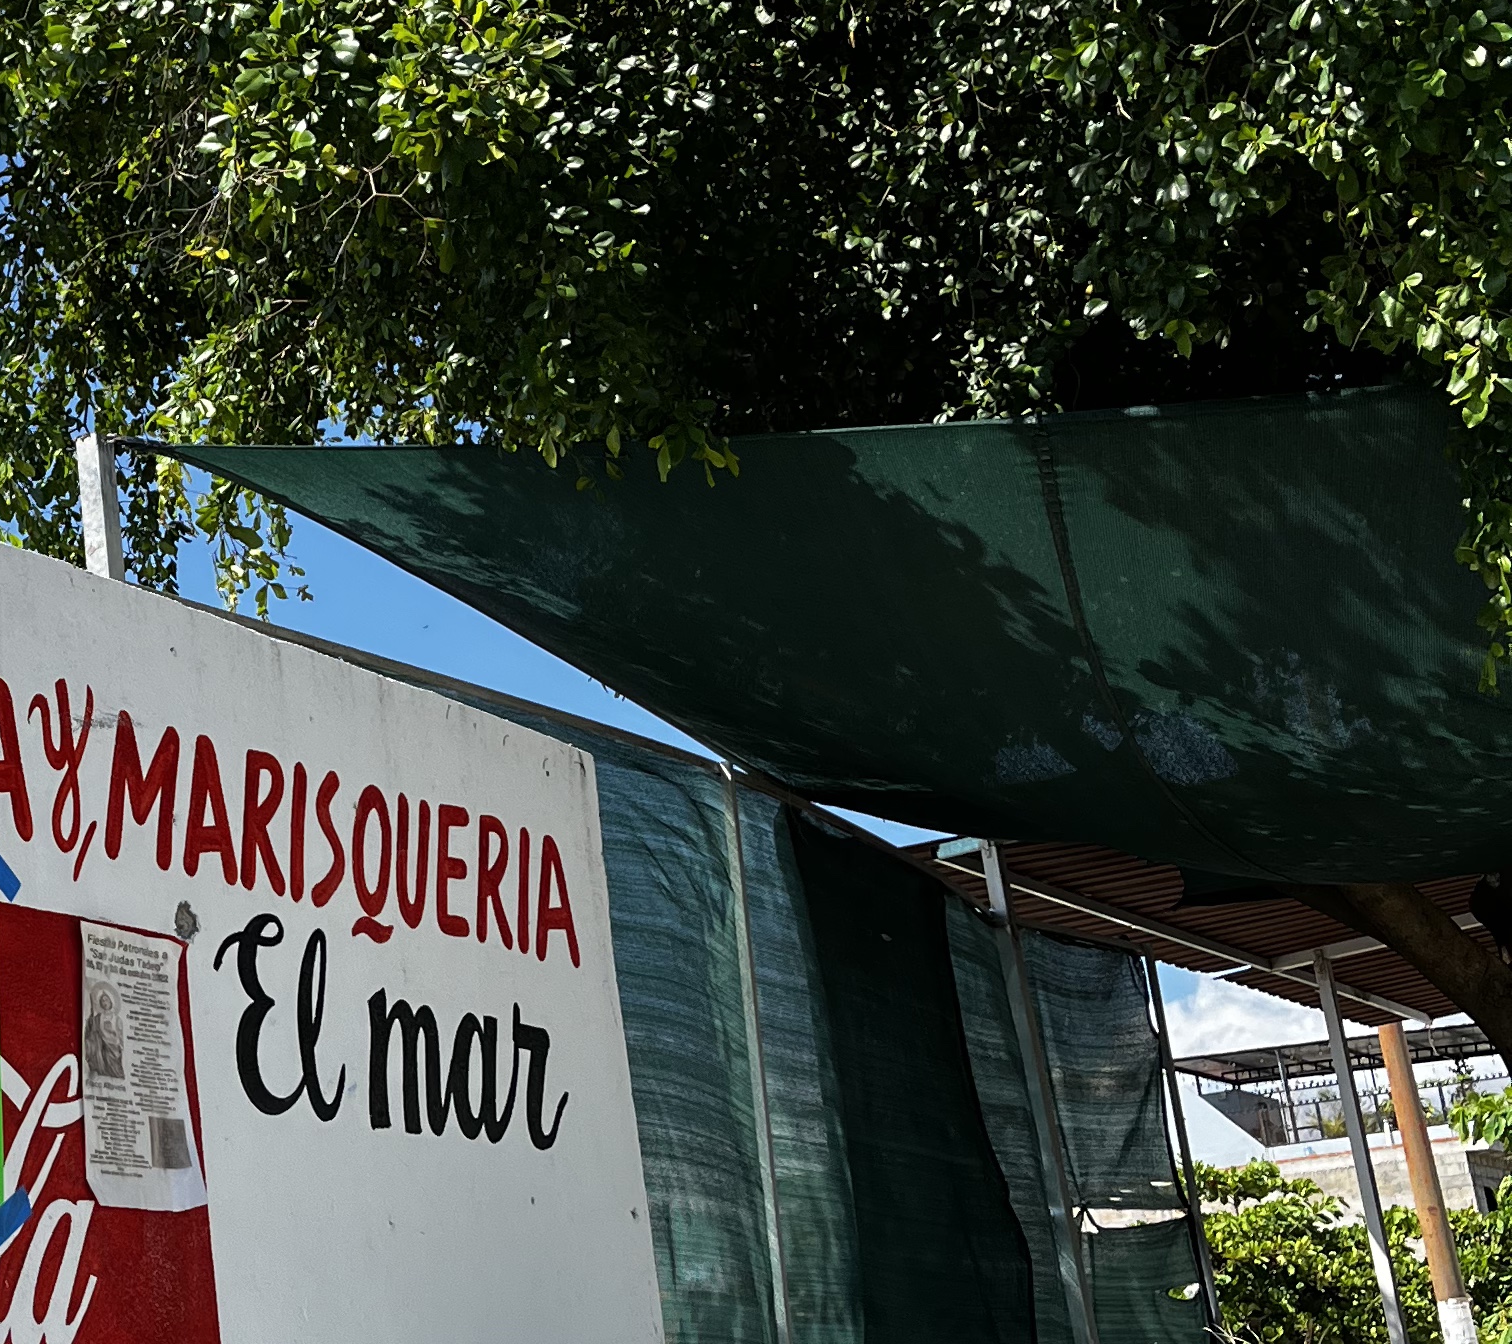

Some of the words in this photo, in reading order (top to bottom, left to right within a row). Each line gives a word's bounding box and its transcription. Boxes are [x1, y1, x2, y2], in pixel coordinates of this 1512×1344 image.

[104, 709, 581, 968] MARISQUERIA
[213, 913, 345, 1122] El
[368, 987, 569, 1150] mar
